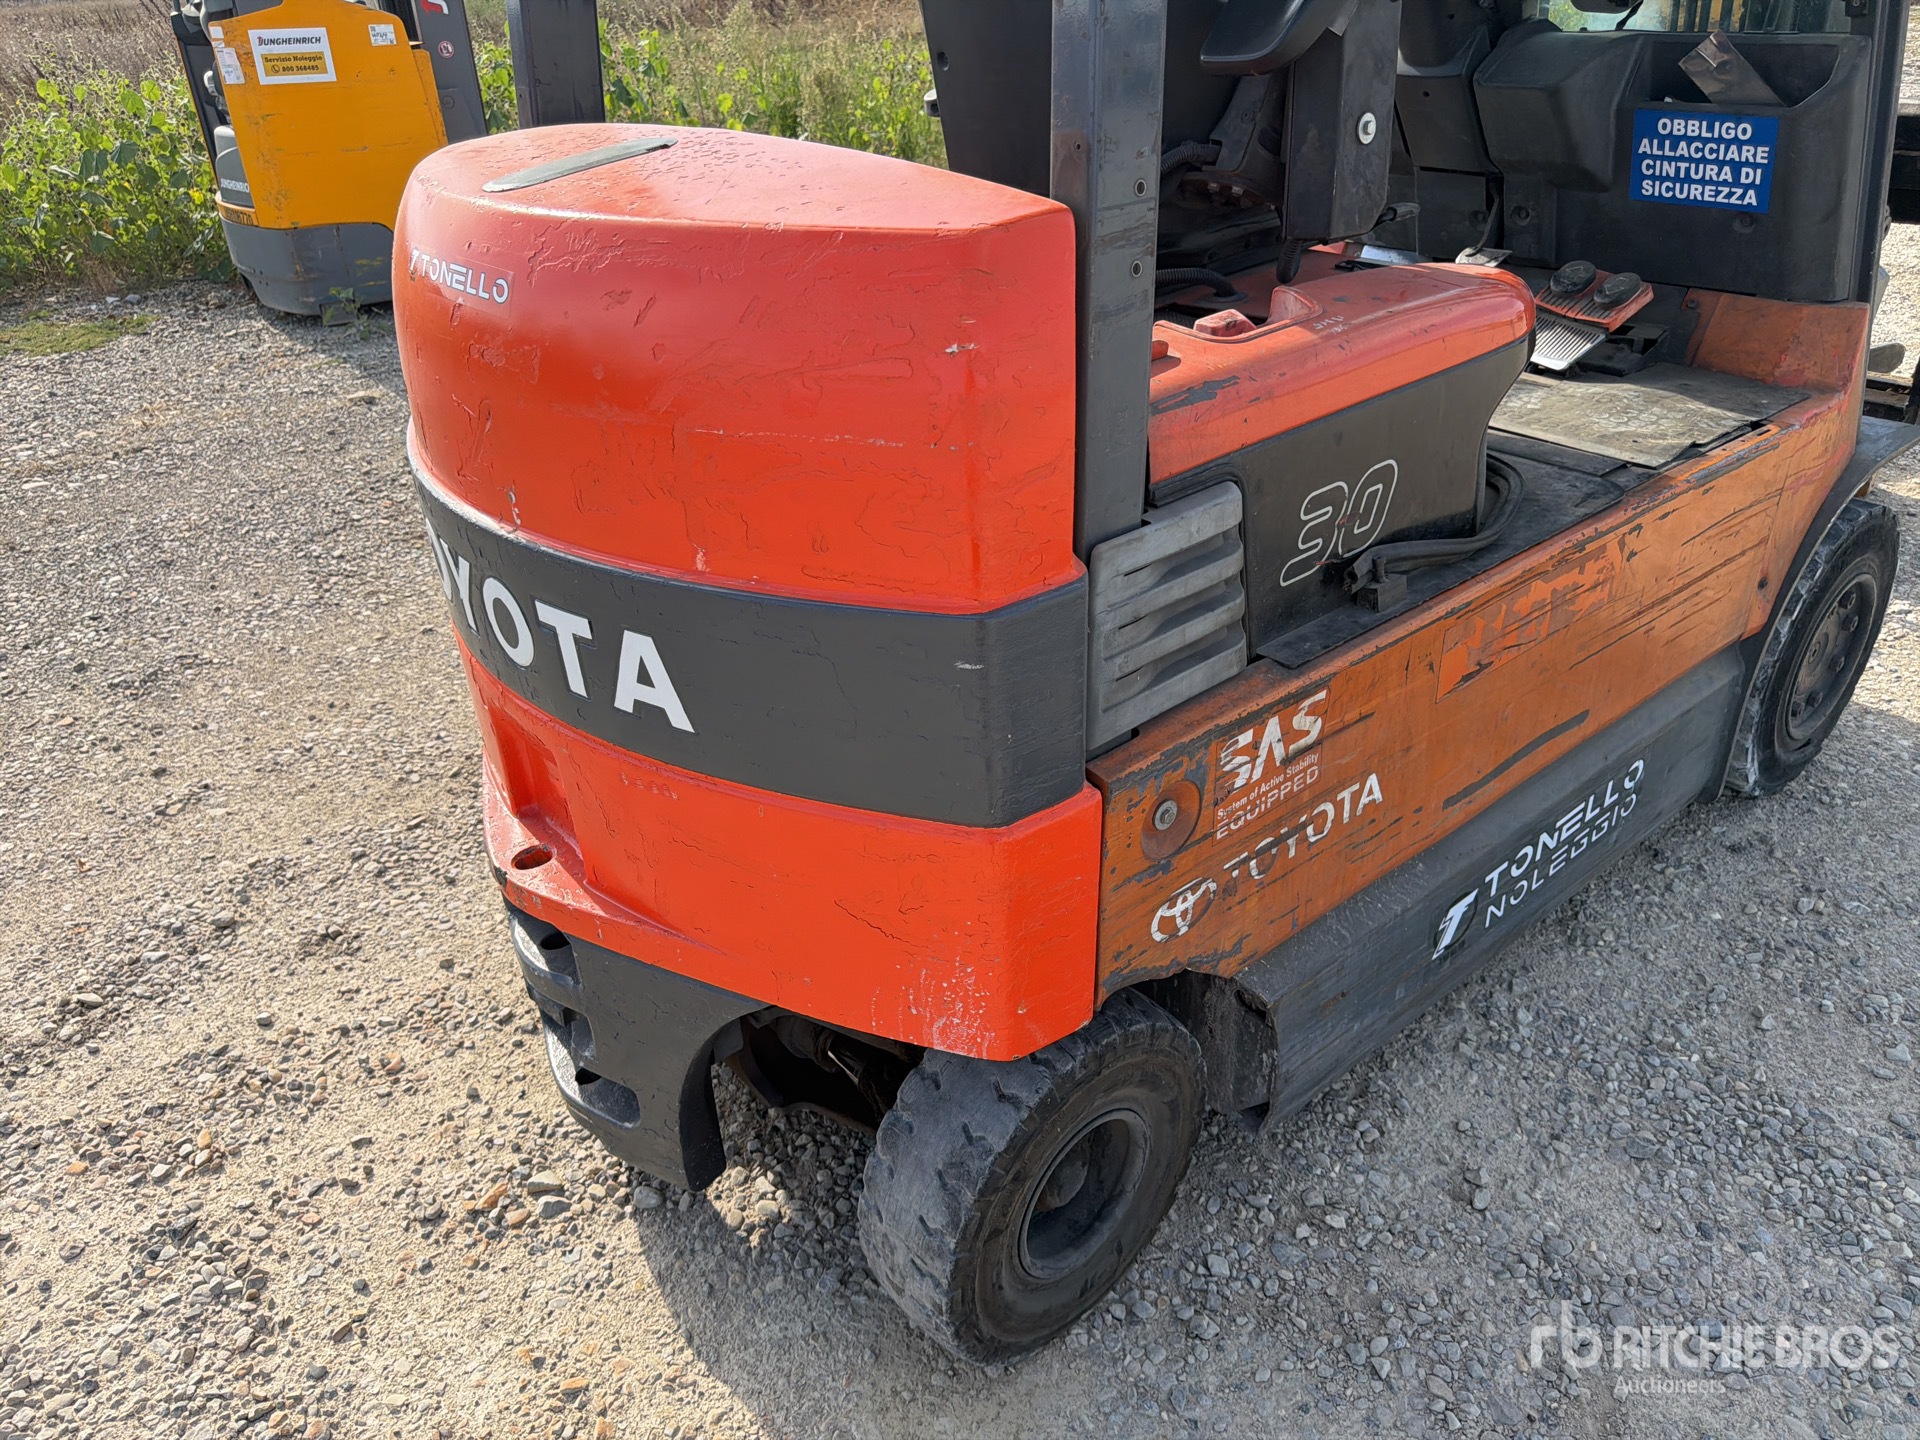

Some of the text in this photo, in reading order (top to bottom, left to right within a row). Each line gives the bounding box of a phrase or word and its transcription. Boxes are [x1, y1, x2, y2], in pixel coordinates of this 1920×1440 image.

[257, 36, 321, 46] JUNGHEINRICH
[264, 54, 323, 64] Servizio Noleggio
[1657, 118, 1752, 140] OBBLIGO
[1638, 138, 1769, 163] ALLACCIARE
[1642, 159, 1762, 185] CINTURA DI
[1642, 180, 1757, 206] SICUREZZA
[421, 254, 509, 304] TONELLO
[1280, 459, 1398, 587] 30
[1216, 766, 1319, 841] EQUIPPED
[1217, 753, 1319, 820] System of Active Stability
[1484, 759, 1645, 897] TONELLO
[1485, 793, 1637, 928] NOLEGGIO
